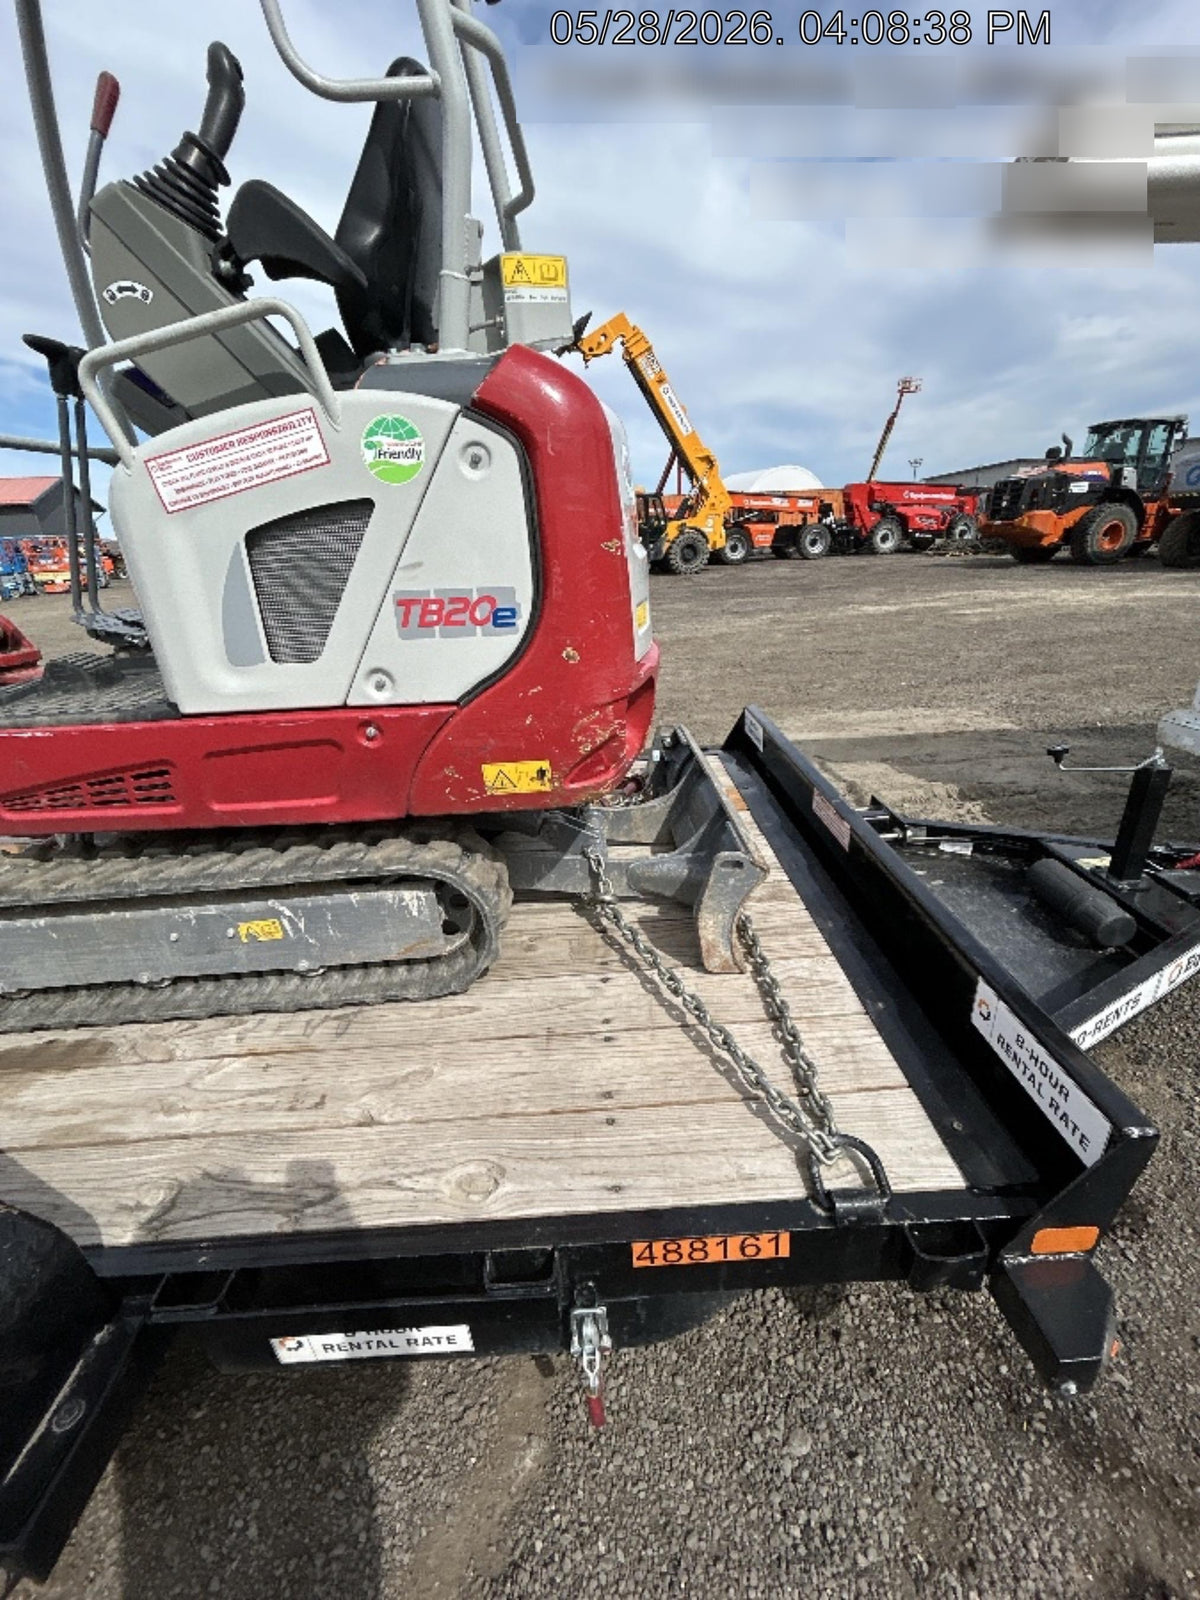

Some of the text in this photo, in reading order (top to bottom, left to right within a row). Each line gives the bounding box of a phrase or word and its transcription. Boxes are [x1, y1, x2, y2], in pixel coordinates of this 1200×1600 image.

[378, 447, 422, 460] Friendly
[396, 595, 517, 628] TB20e
[1015, 1033, 1070, 1103] 8-HOUR
[997, 1033, 1091, 1153] RENTAL RATE
[636, 1232, 781, 1265] 488161
[322, 1334, 458, 1354] RENTAL RATE
